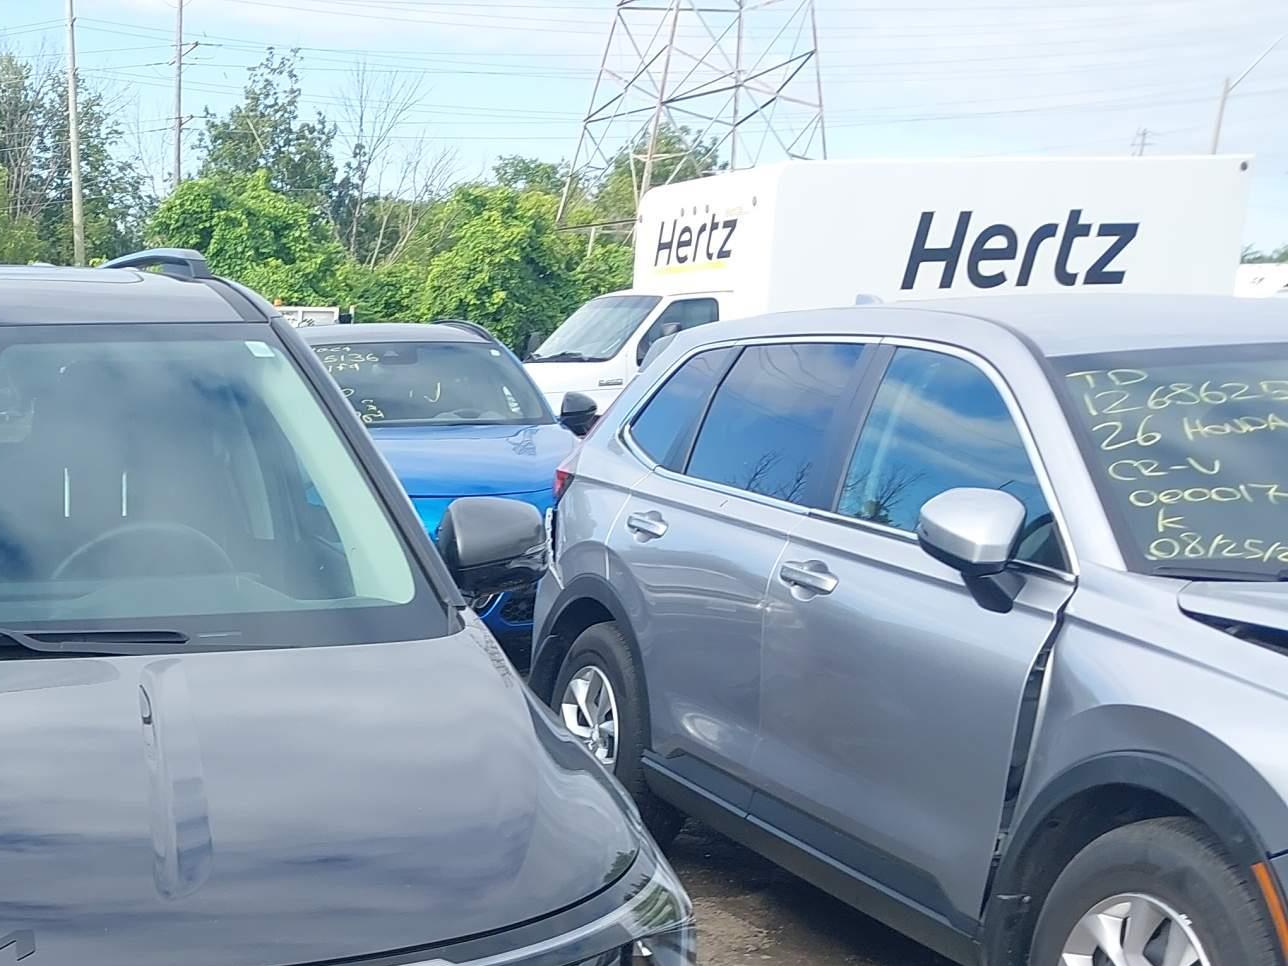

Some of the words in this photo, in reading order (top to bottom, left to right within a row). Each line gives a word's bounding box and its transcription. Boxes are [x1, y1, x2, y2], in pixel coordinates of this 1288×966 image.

[654, 213, 738, 267] Hertz
[900, 208, 1140, 290] Hertz
[1065, 368, 1149, 389] TD
[1092, 414, 1162, 451] 26
[1157, 508, 1189, 533] K
